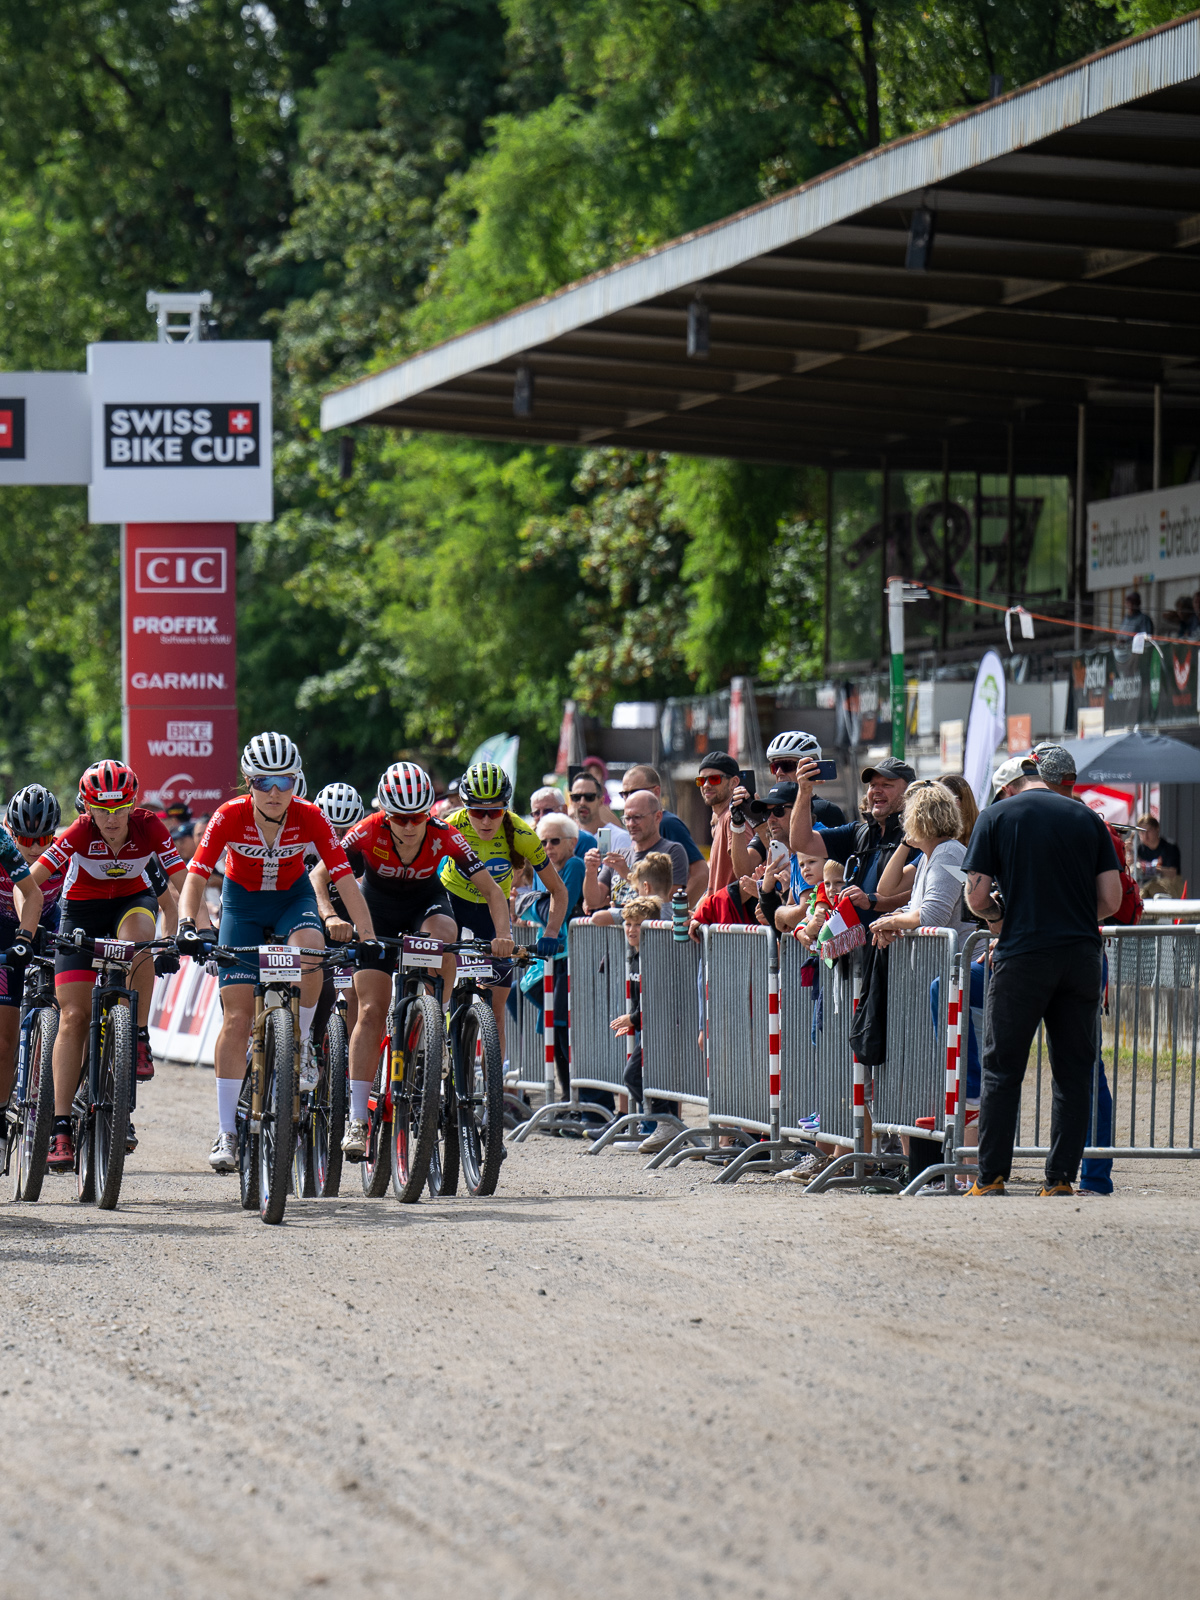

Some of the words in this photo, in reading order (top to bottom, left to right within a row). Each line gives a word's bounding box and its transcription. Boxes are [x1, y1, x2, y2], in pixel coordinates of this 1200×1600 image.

[110, 408, 213, 436] SWISS
[110, 436, 183, 463] BIKE
[190, 436, 256, 463] CUP
[146, 557, 216, 584] CIC
[132, 615, 219, 635] PROFFIX
[131, 671, 225, 690] GARMIN
[170, 724, 209, 738] BIKE
[147, 740, 214, 757] WORLD
[200, 811, 221, 848] Benexe
[340, 824, 368, 849] BMC
[238, 845, 304, 859] Wilier
[451, 833, 478, 862] BMC
[377, 864, 434, 880] BMC
[103, 944, 126, 960] 1001
[409, 940, 439, 951] 1605
[267, 954, 294, 967] 1003
[230, 972, 257, 980] vittoria
